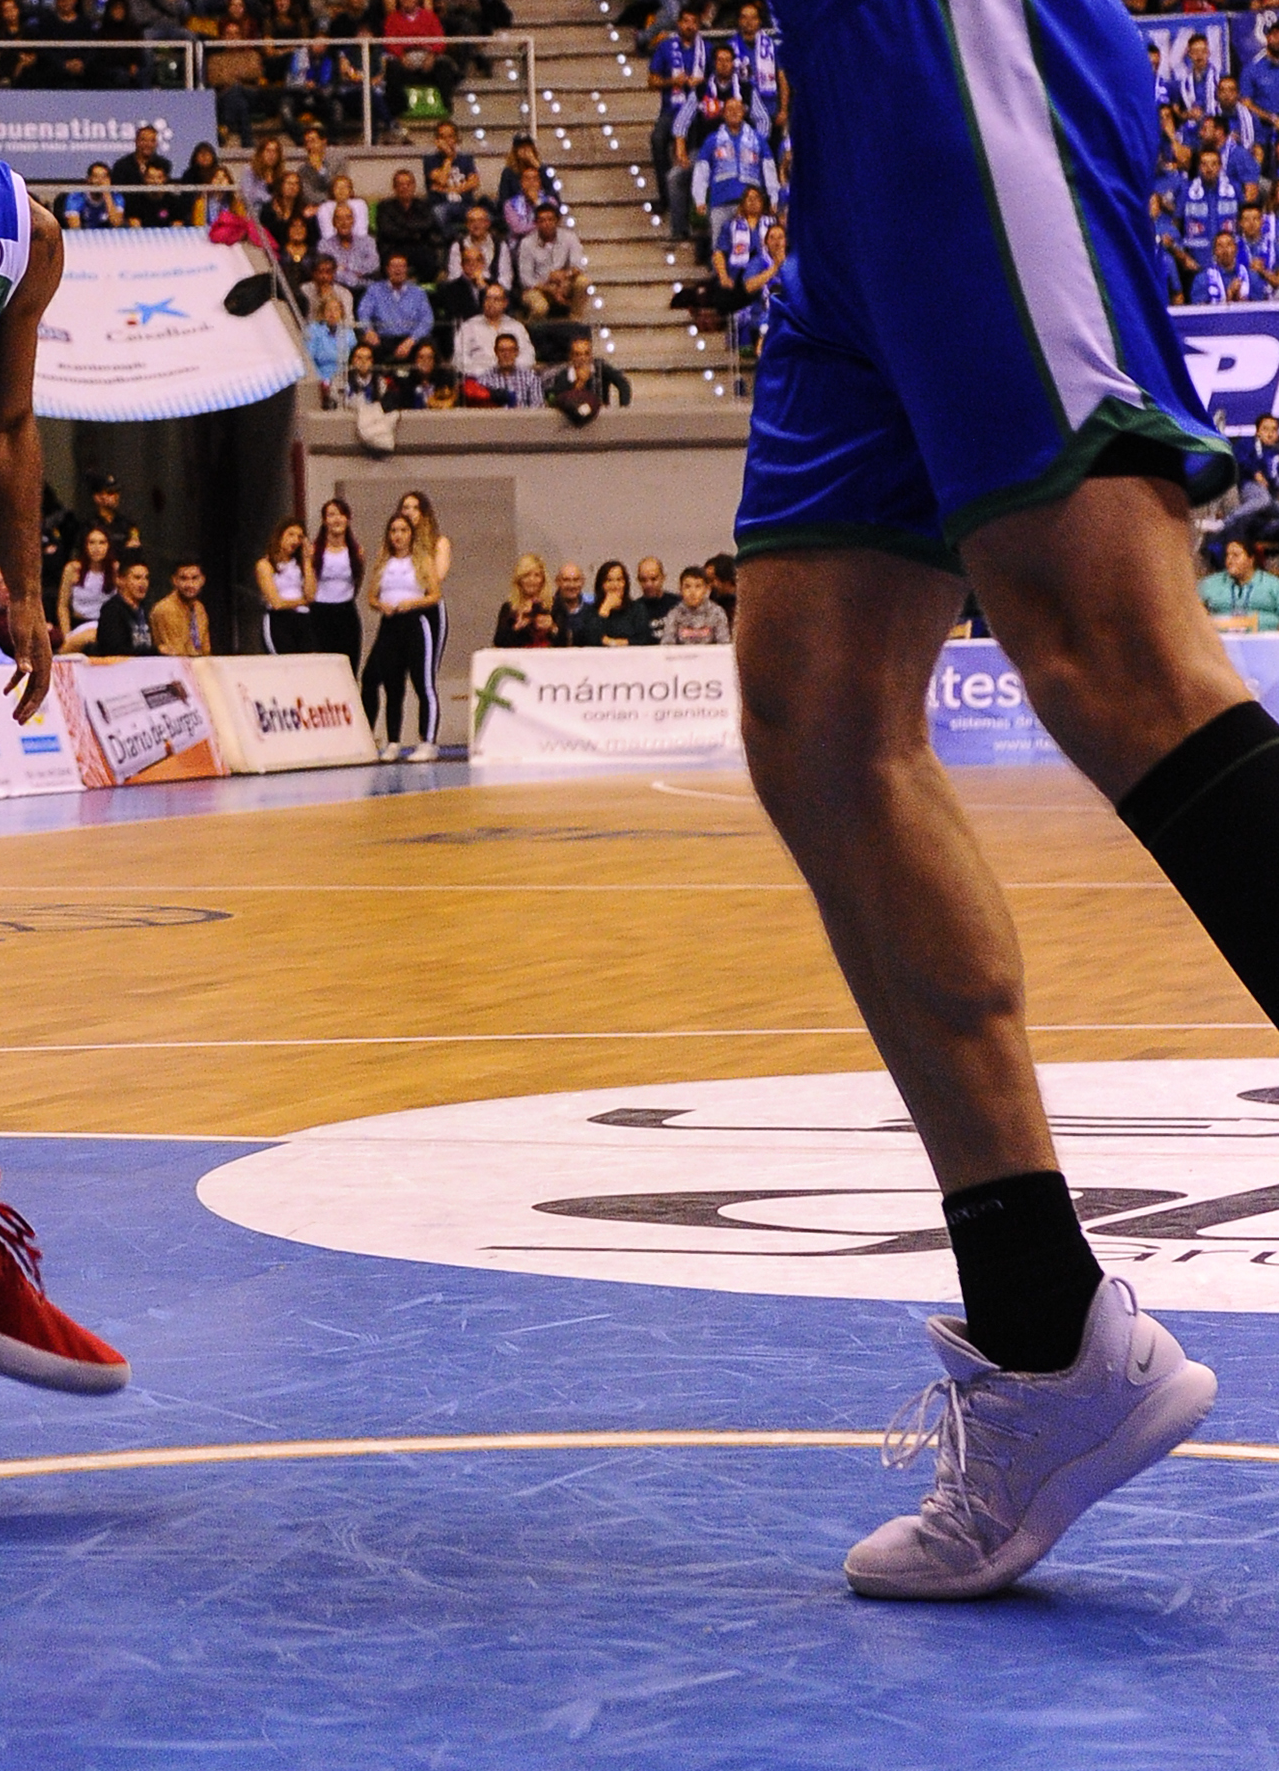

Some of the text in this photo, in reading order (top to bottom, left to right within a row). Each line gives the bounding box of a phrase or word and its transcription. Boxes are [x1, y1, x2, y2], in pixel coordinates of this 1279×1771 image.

[538, 675, 723, 703] mármoles
[255, 696, 354, 735] BricoCentro
[583, 709, 639, 722] corian
[654, 706, 729, 723] granitos
[107, 709, 205, 765] Diario de Burgos
